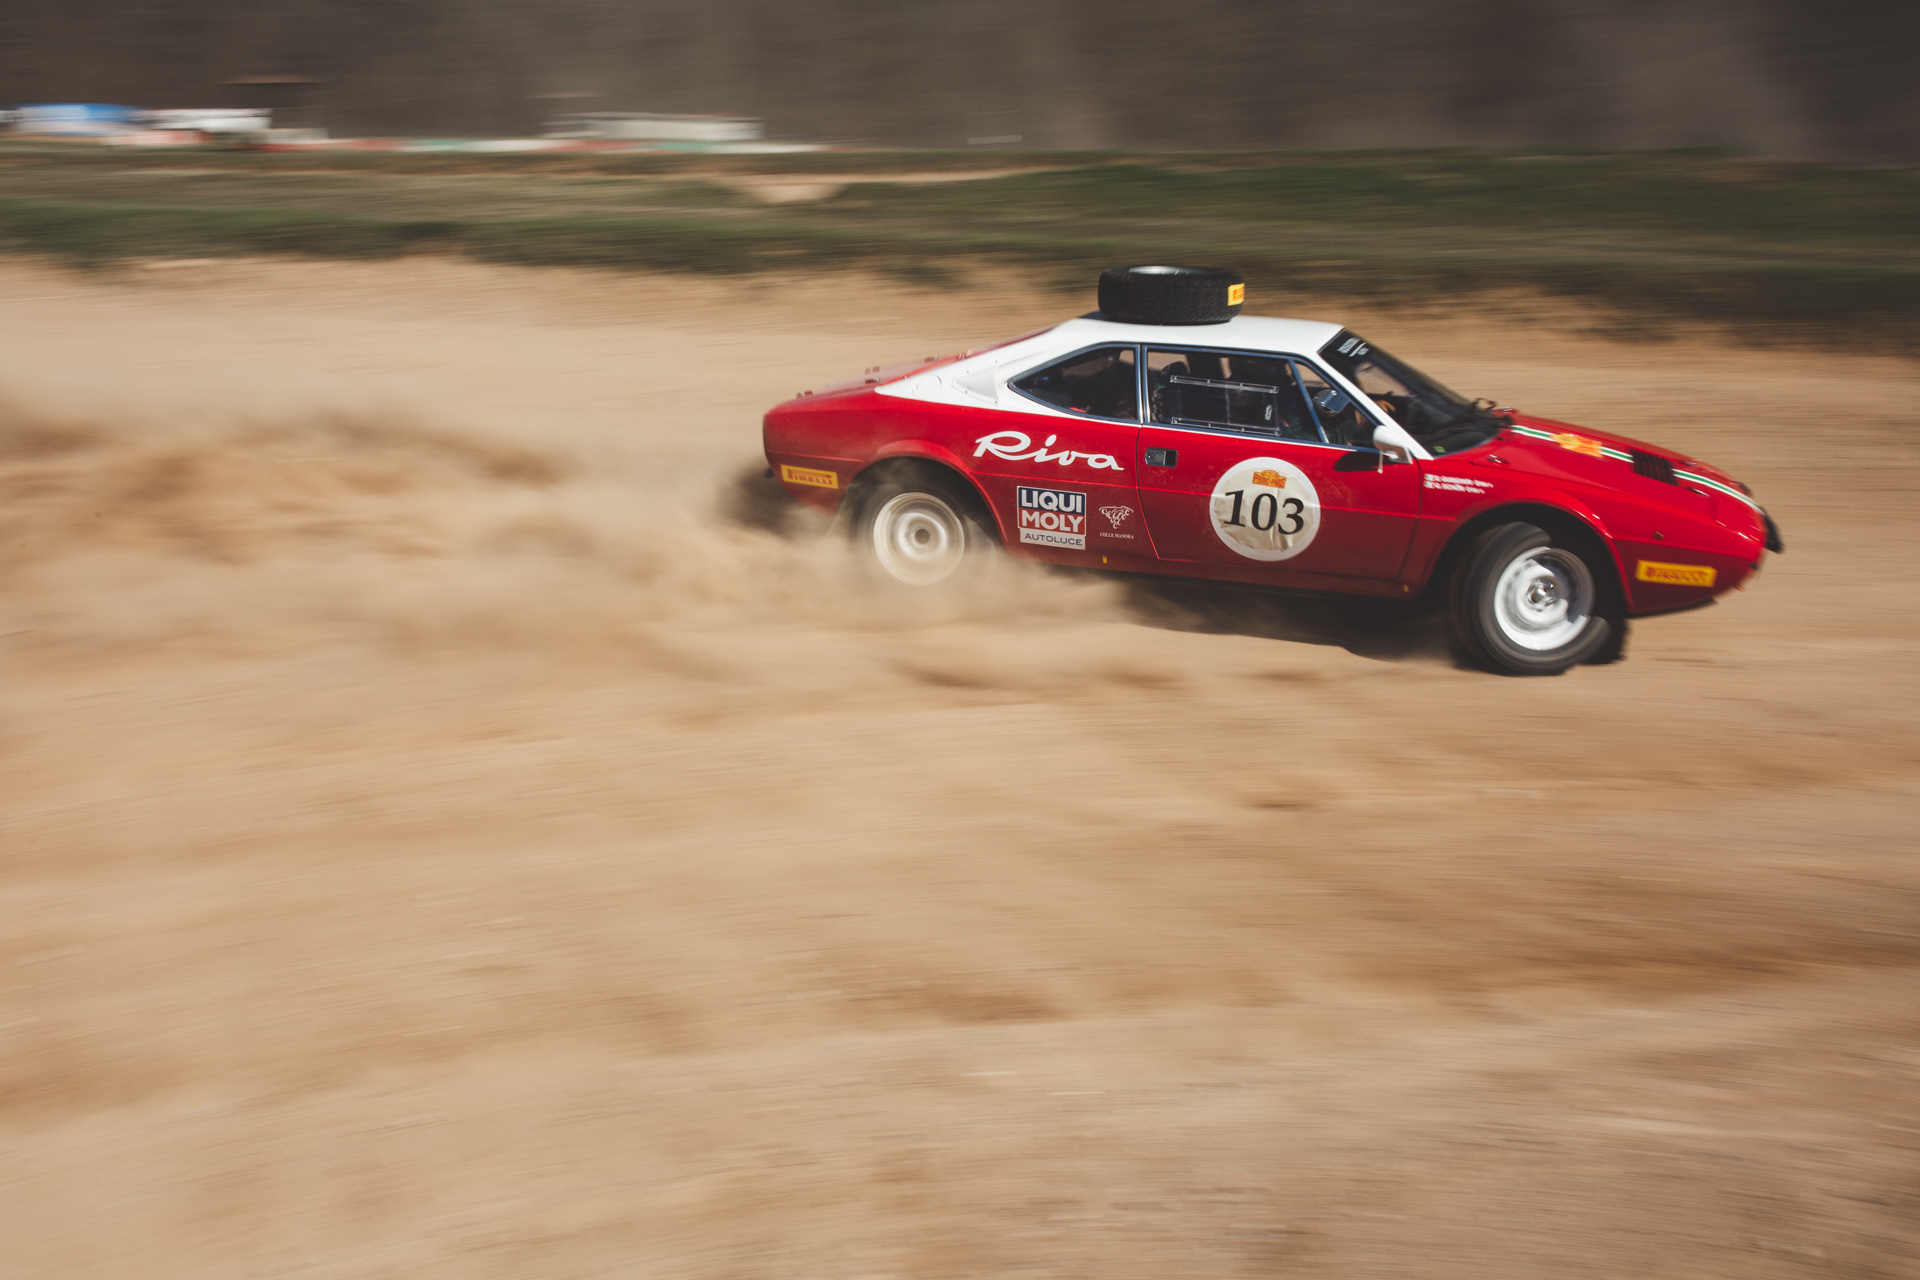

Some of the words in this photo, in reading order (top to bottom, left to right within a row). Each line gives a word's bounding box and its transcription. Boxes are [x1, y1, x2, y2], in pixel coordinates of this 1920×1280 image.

[973, 430, 1125, 471] Riva
[787, 468, 833, 486] PIRELLI
[1021, 489, 1082, 513] LIQUI
[1223, 489, 1305, 535] 103
[1021, 510, 1084, 533] MOLY
[1024, 532, 1083, 546] AUTOLUCE
